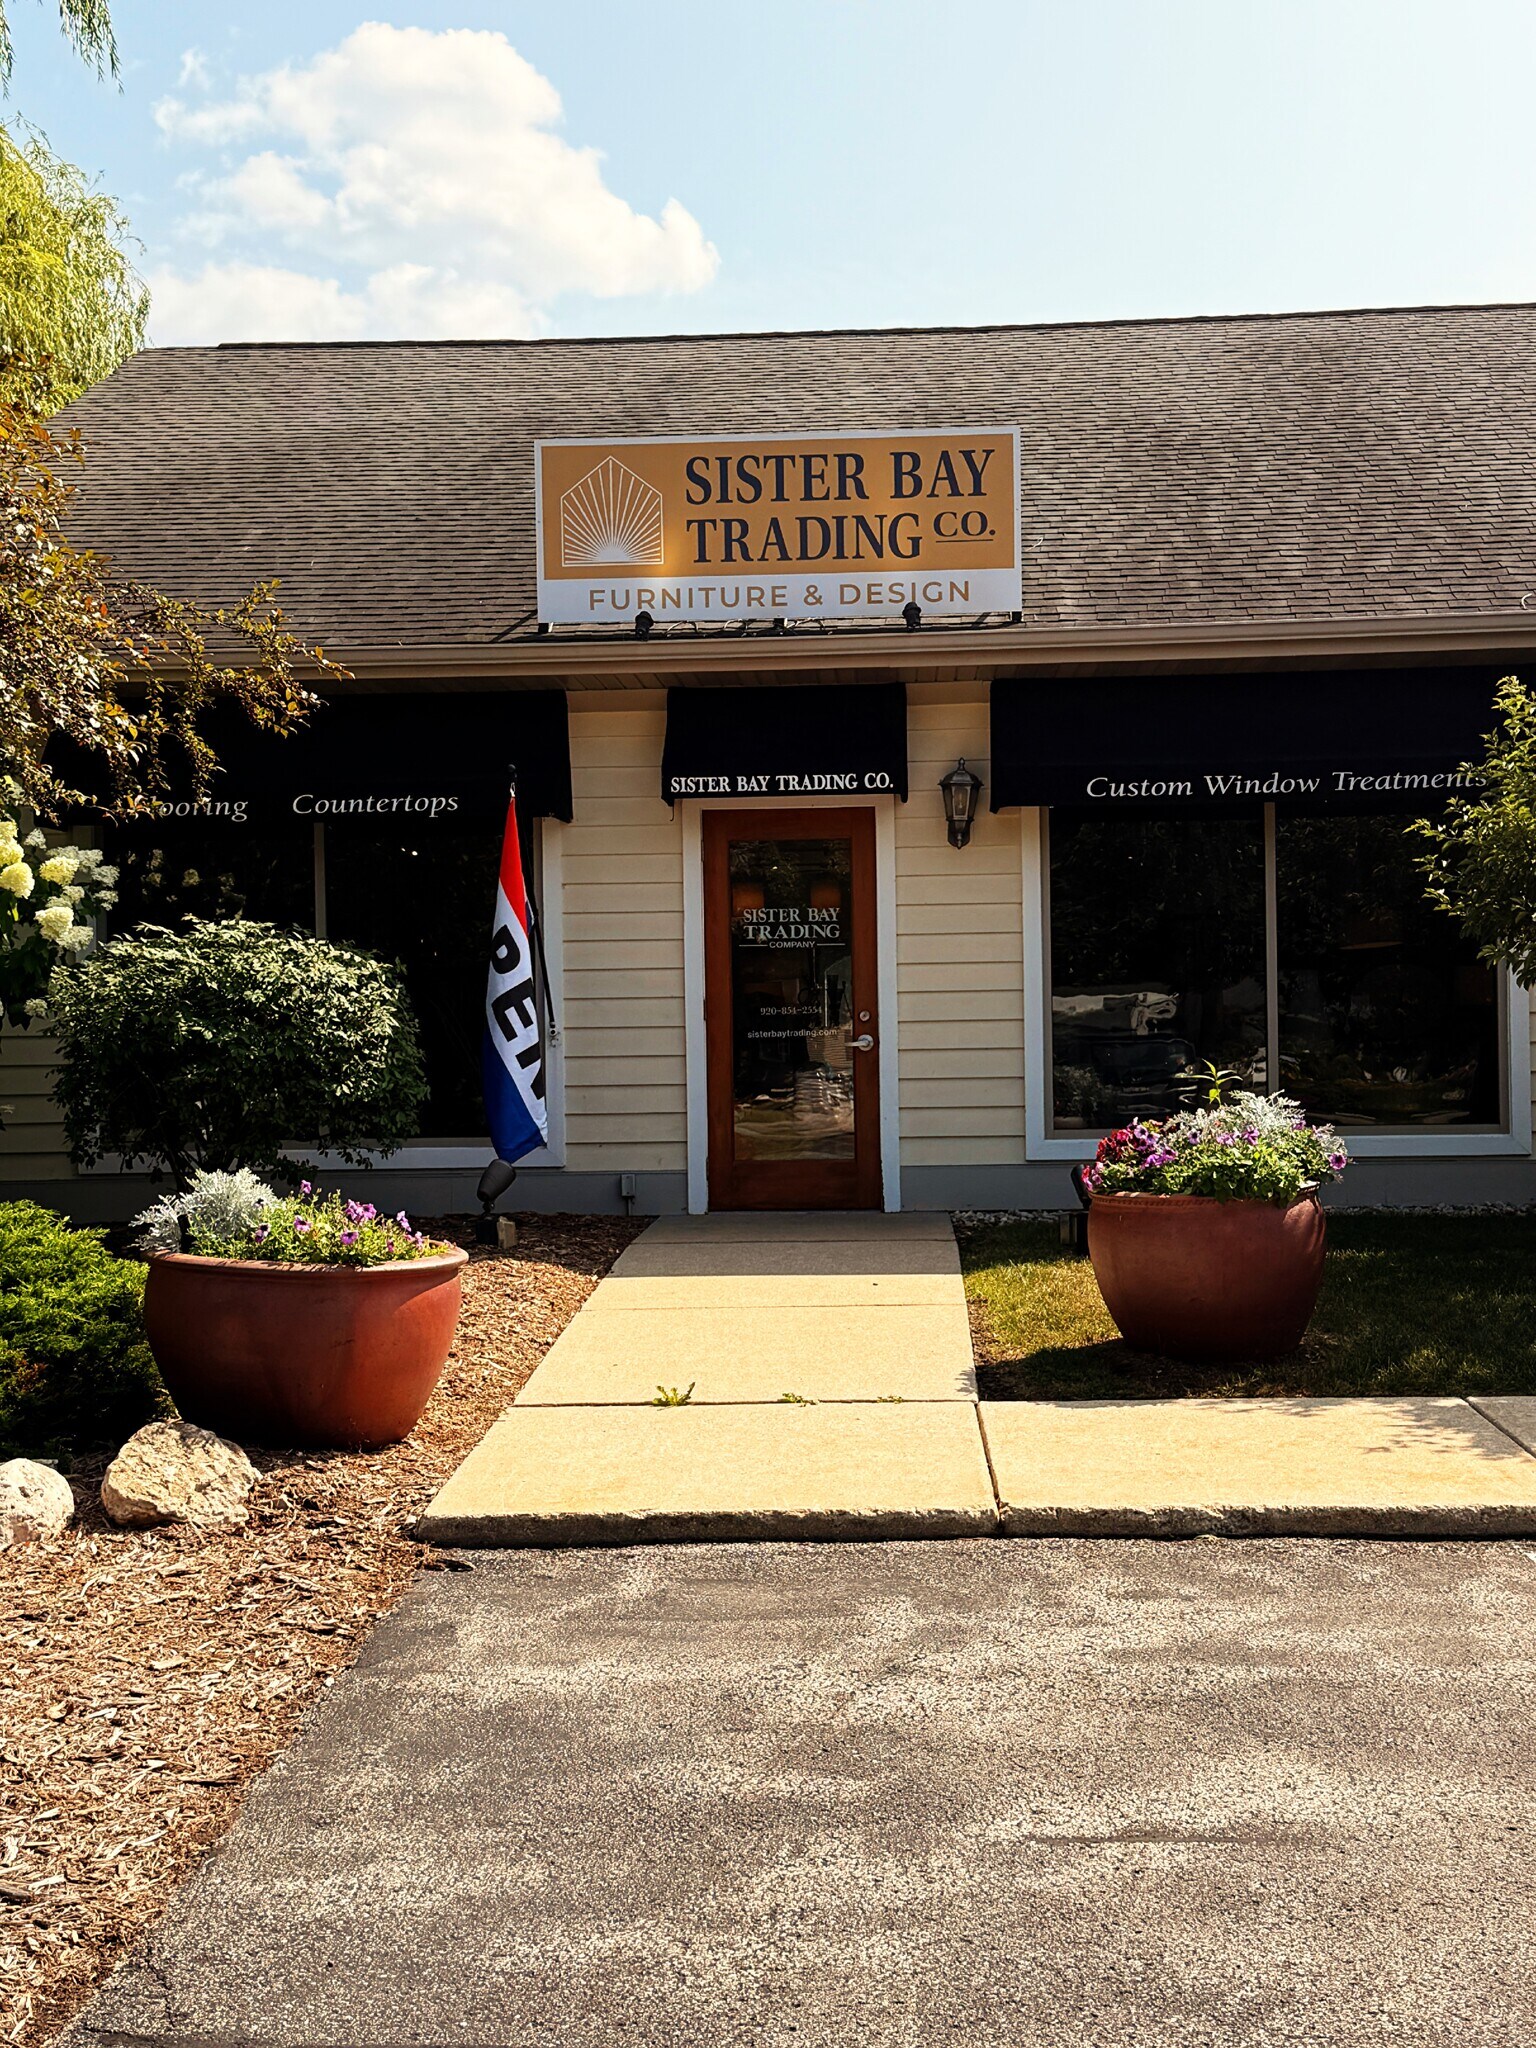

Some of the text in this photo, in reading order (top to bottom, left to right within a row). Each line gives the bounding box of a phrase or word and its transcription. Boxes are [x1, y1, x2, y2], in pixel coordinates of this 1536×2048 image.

[685, 448, 995, 505] SISTER BAY
[686, 510, 996, 564] TRADING CO.
[589, 579, 971, 611] FURNITURE & DESIGN
[670, 772, 894, 793] SISTER BAY TRADING CO.
[1086, 771, 1488, 798] Custom Window Treatments
[292, 793, 459, 818] Countertops
[743, 907, 840, 923] SISTER BAY
[743, 924, 840, 940] TRADING
[747, 1029, 838, 1039] sisterbaytrading.com
